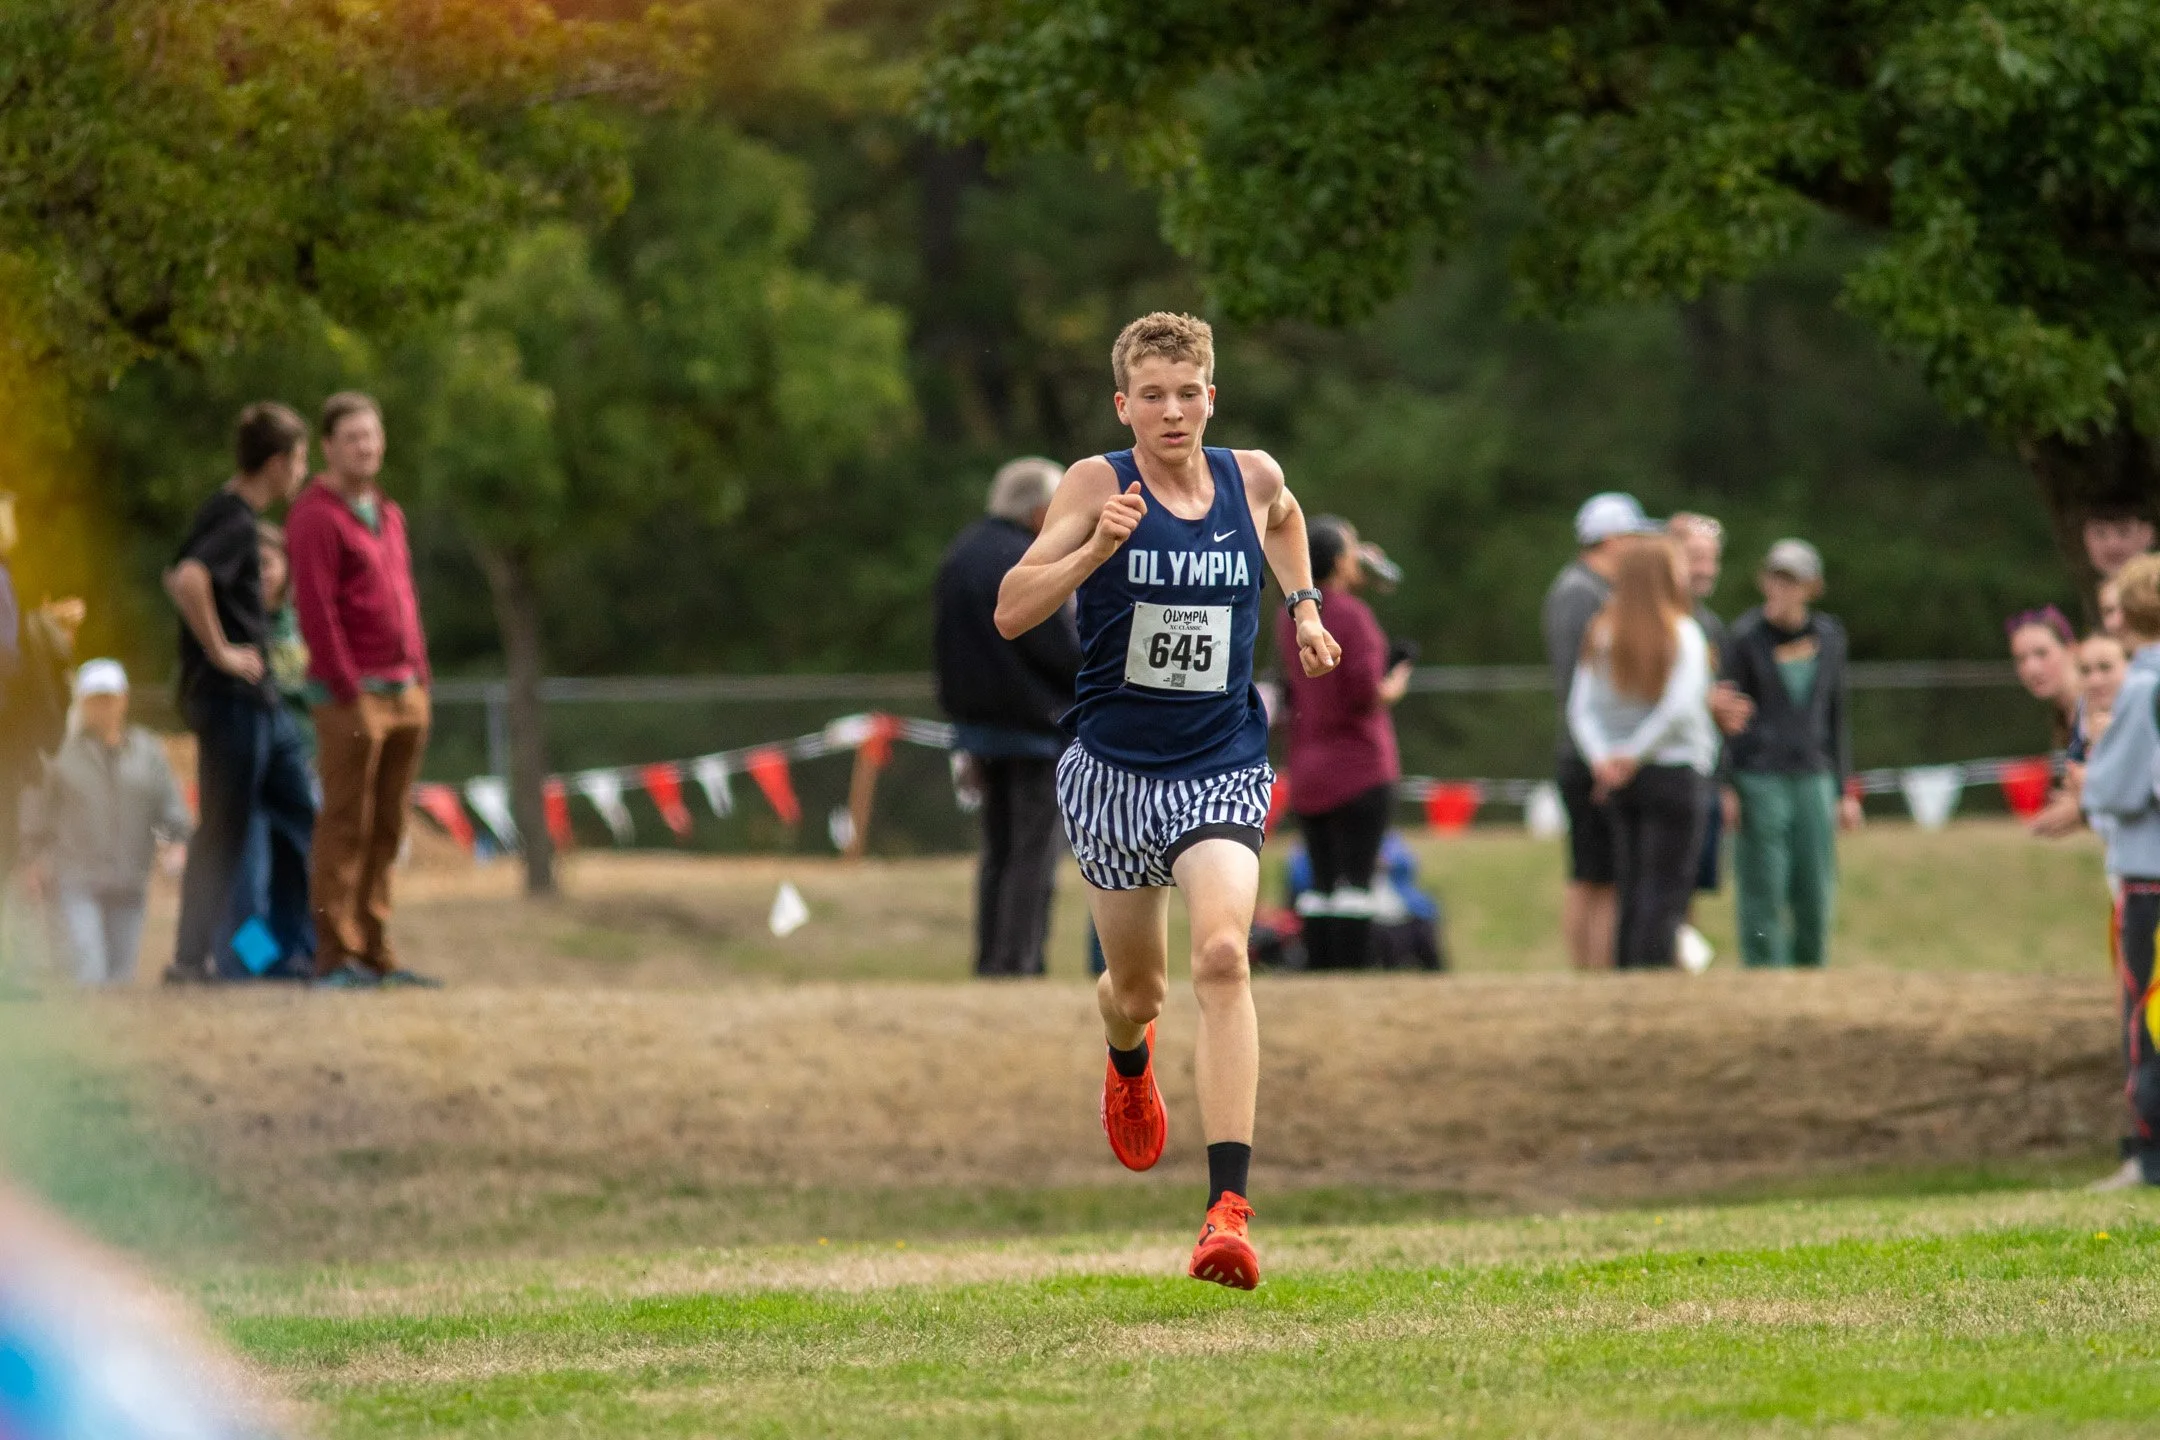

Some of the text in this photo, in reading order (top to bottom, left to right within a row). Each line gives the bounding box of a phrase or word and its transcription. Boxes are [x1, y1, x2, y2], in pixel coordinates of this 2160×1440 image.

[1128, 549, 1249, 586] OLYMPIA
[1163, 608, 1209, 626] OLYMPIA
[1148, 632, 1213, 672] 645
